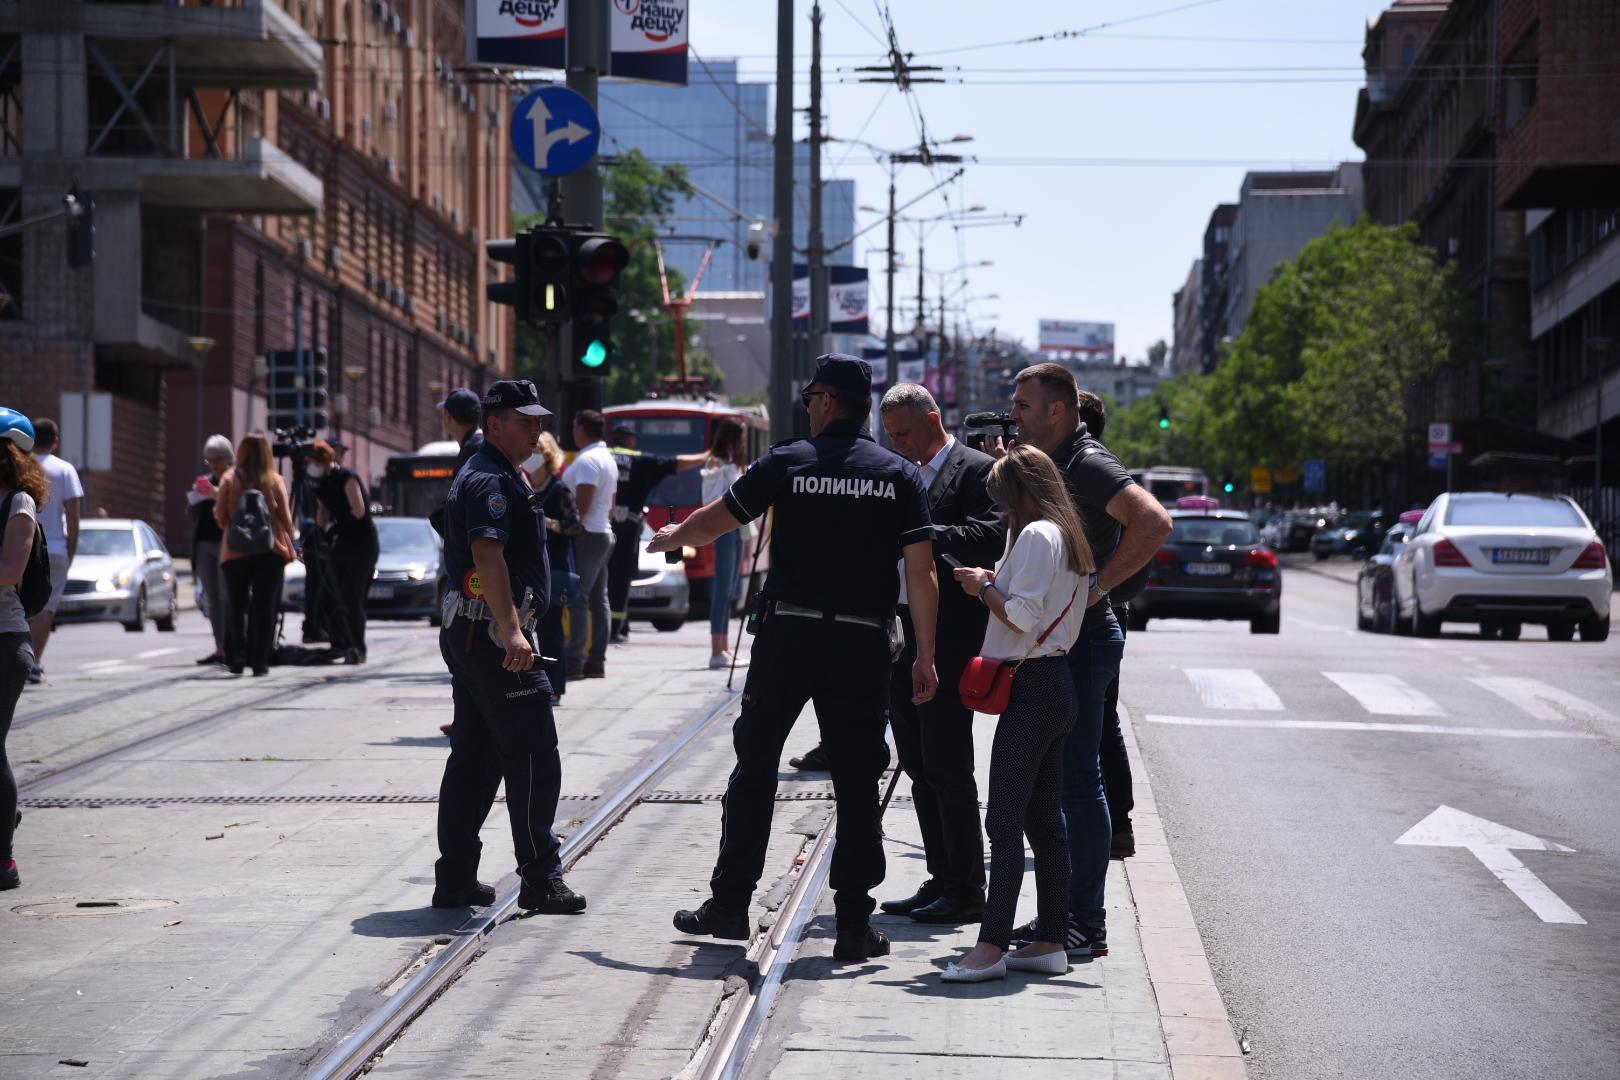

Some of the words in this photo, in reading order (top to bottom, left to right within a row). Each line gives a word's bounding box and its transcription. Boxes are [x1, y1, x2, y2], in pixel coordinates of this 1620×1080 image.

[499, 1, 554, 21] децу.
[640, 4, 684, 24] нашу
[631, 15, 679, 36] децу.
[792, 476, 897, 500] ПОЛИЦИЈА
